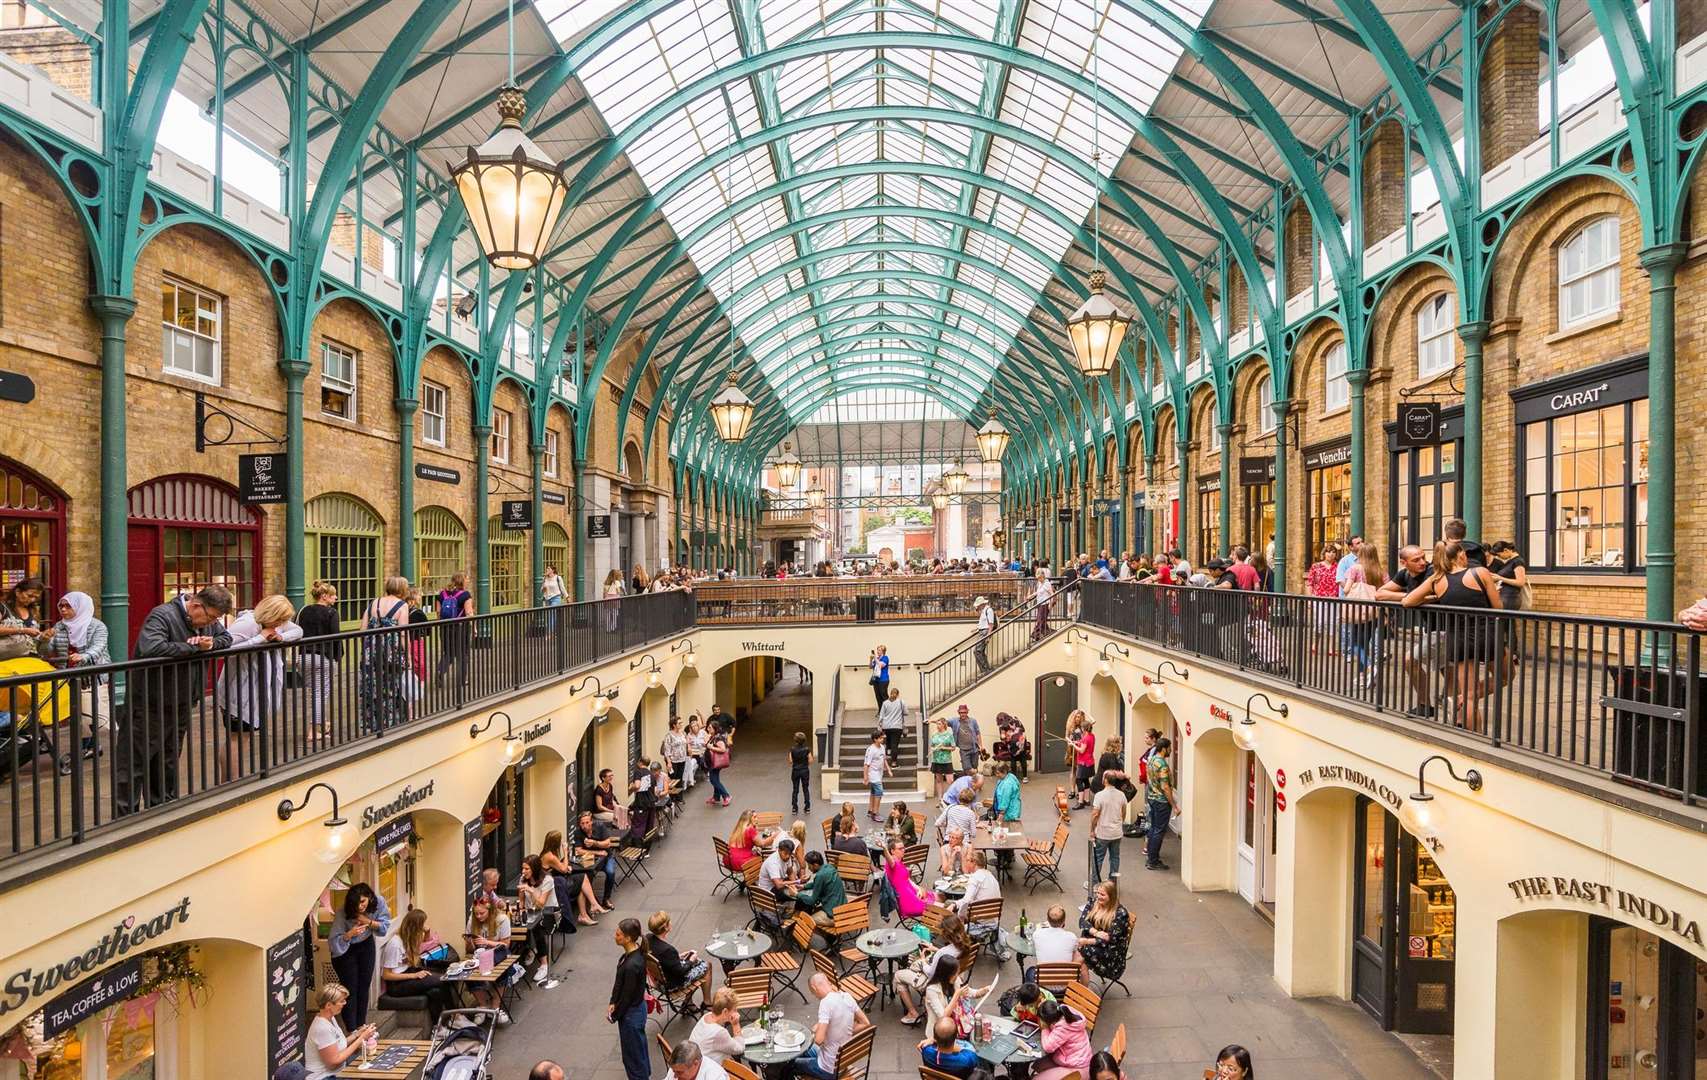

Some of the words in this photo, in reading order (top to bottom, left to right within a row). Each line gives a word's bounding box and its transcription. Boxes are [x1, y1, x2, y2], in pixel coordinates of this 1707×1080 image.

[1319, 447, 1347, 465] Venchi
[742, 641, 785, 651] Whittard
[1318, 764, 1344, 779] EAST
[1345, 767, 1378, 794] INDIA
[361, 779, 435, 830] Sweetheart
[1508, 876, 1551, 899] THE
[1552, 876, 1612, 905] EAST
[1616, 889, 1704, 948] INDIA
[0, 896, 191, 1016] Sweetheart
[115, 970, 139, 993] LOVE
